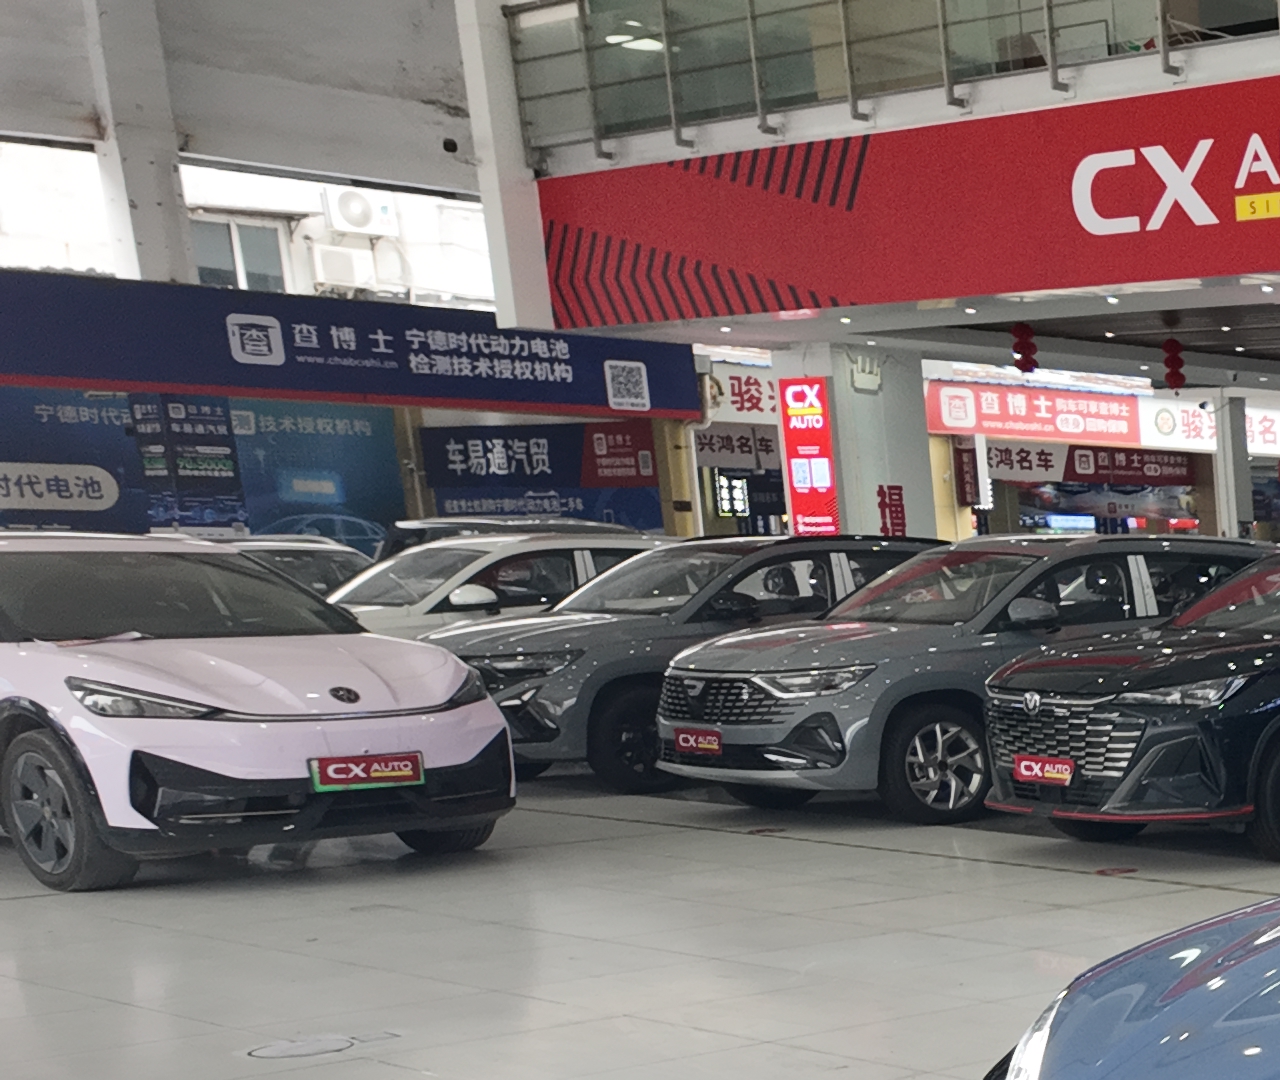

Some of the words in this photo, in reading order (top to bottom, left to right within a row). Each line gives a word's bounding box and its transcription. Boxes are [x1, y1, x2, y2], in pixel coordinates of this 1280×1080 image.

[1071, 138, 1220, 236] CX
[291, 323, 394, 353] 查博士
[404, 328, 571, 360] 宁德时代动力电池
[408, 352, 574, 383] 检测技术授权机构
[785, 384, 821, 409] CX
[980, 391, 1053, 418] 查博士
[1055, 397, 1130, 417] 购车可享查博士
[789, 415, 823, 429] AUTO
[446, 438, 552, 476] 车易通汽贸
[678, 733, 698, 748] CX
[697, 735, 720, 747] AUTO
[326, 761, 367, 779] CX
[370, 759, 414, 772] AUTO
[1019, 760, 1043, 778] CX
[1043, 763, 1071, 775] AUTO
